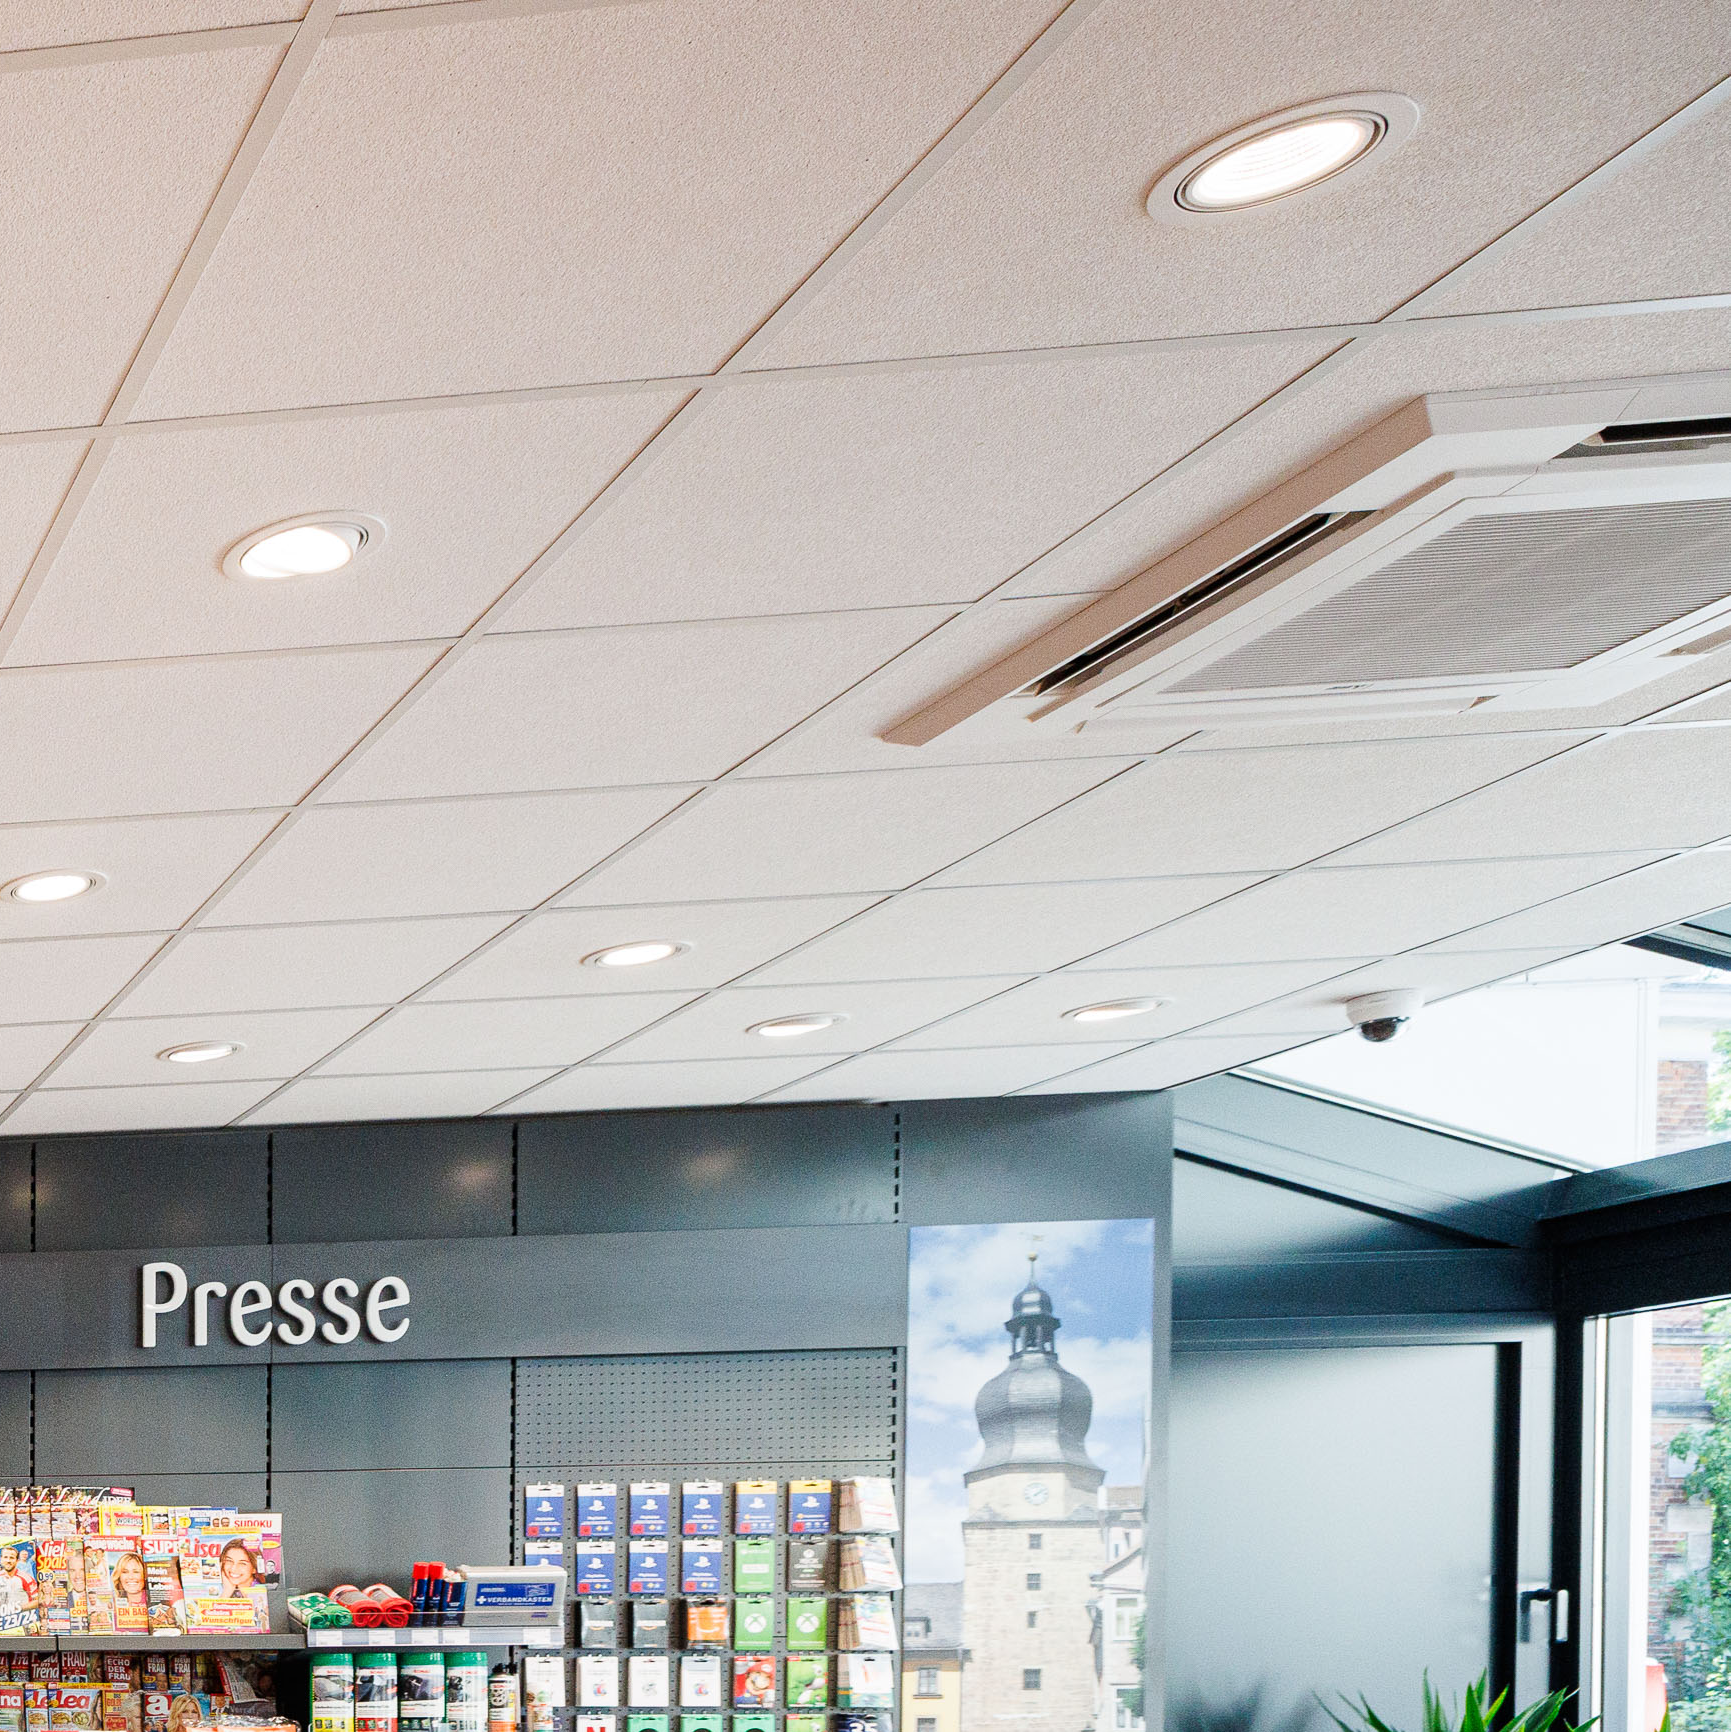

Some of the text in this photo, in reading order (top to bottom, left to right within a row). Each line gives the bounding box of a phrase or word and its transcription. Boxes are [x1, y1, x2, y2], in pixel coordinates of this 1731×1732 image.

[142, 1262, 410, 1347] Presse
[234, 1520, 272, 1529] SUDOKU
[2, 1611, 37, 1630] 23/24
